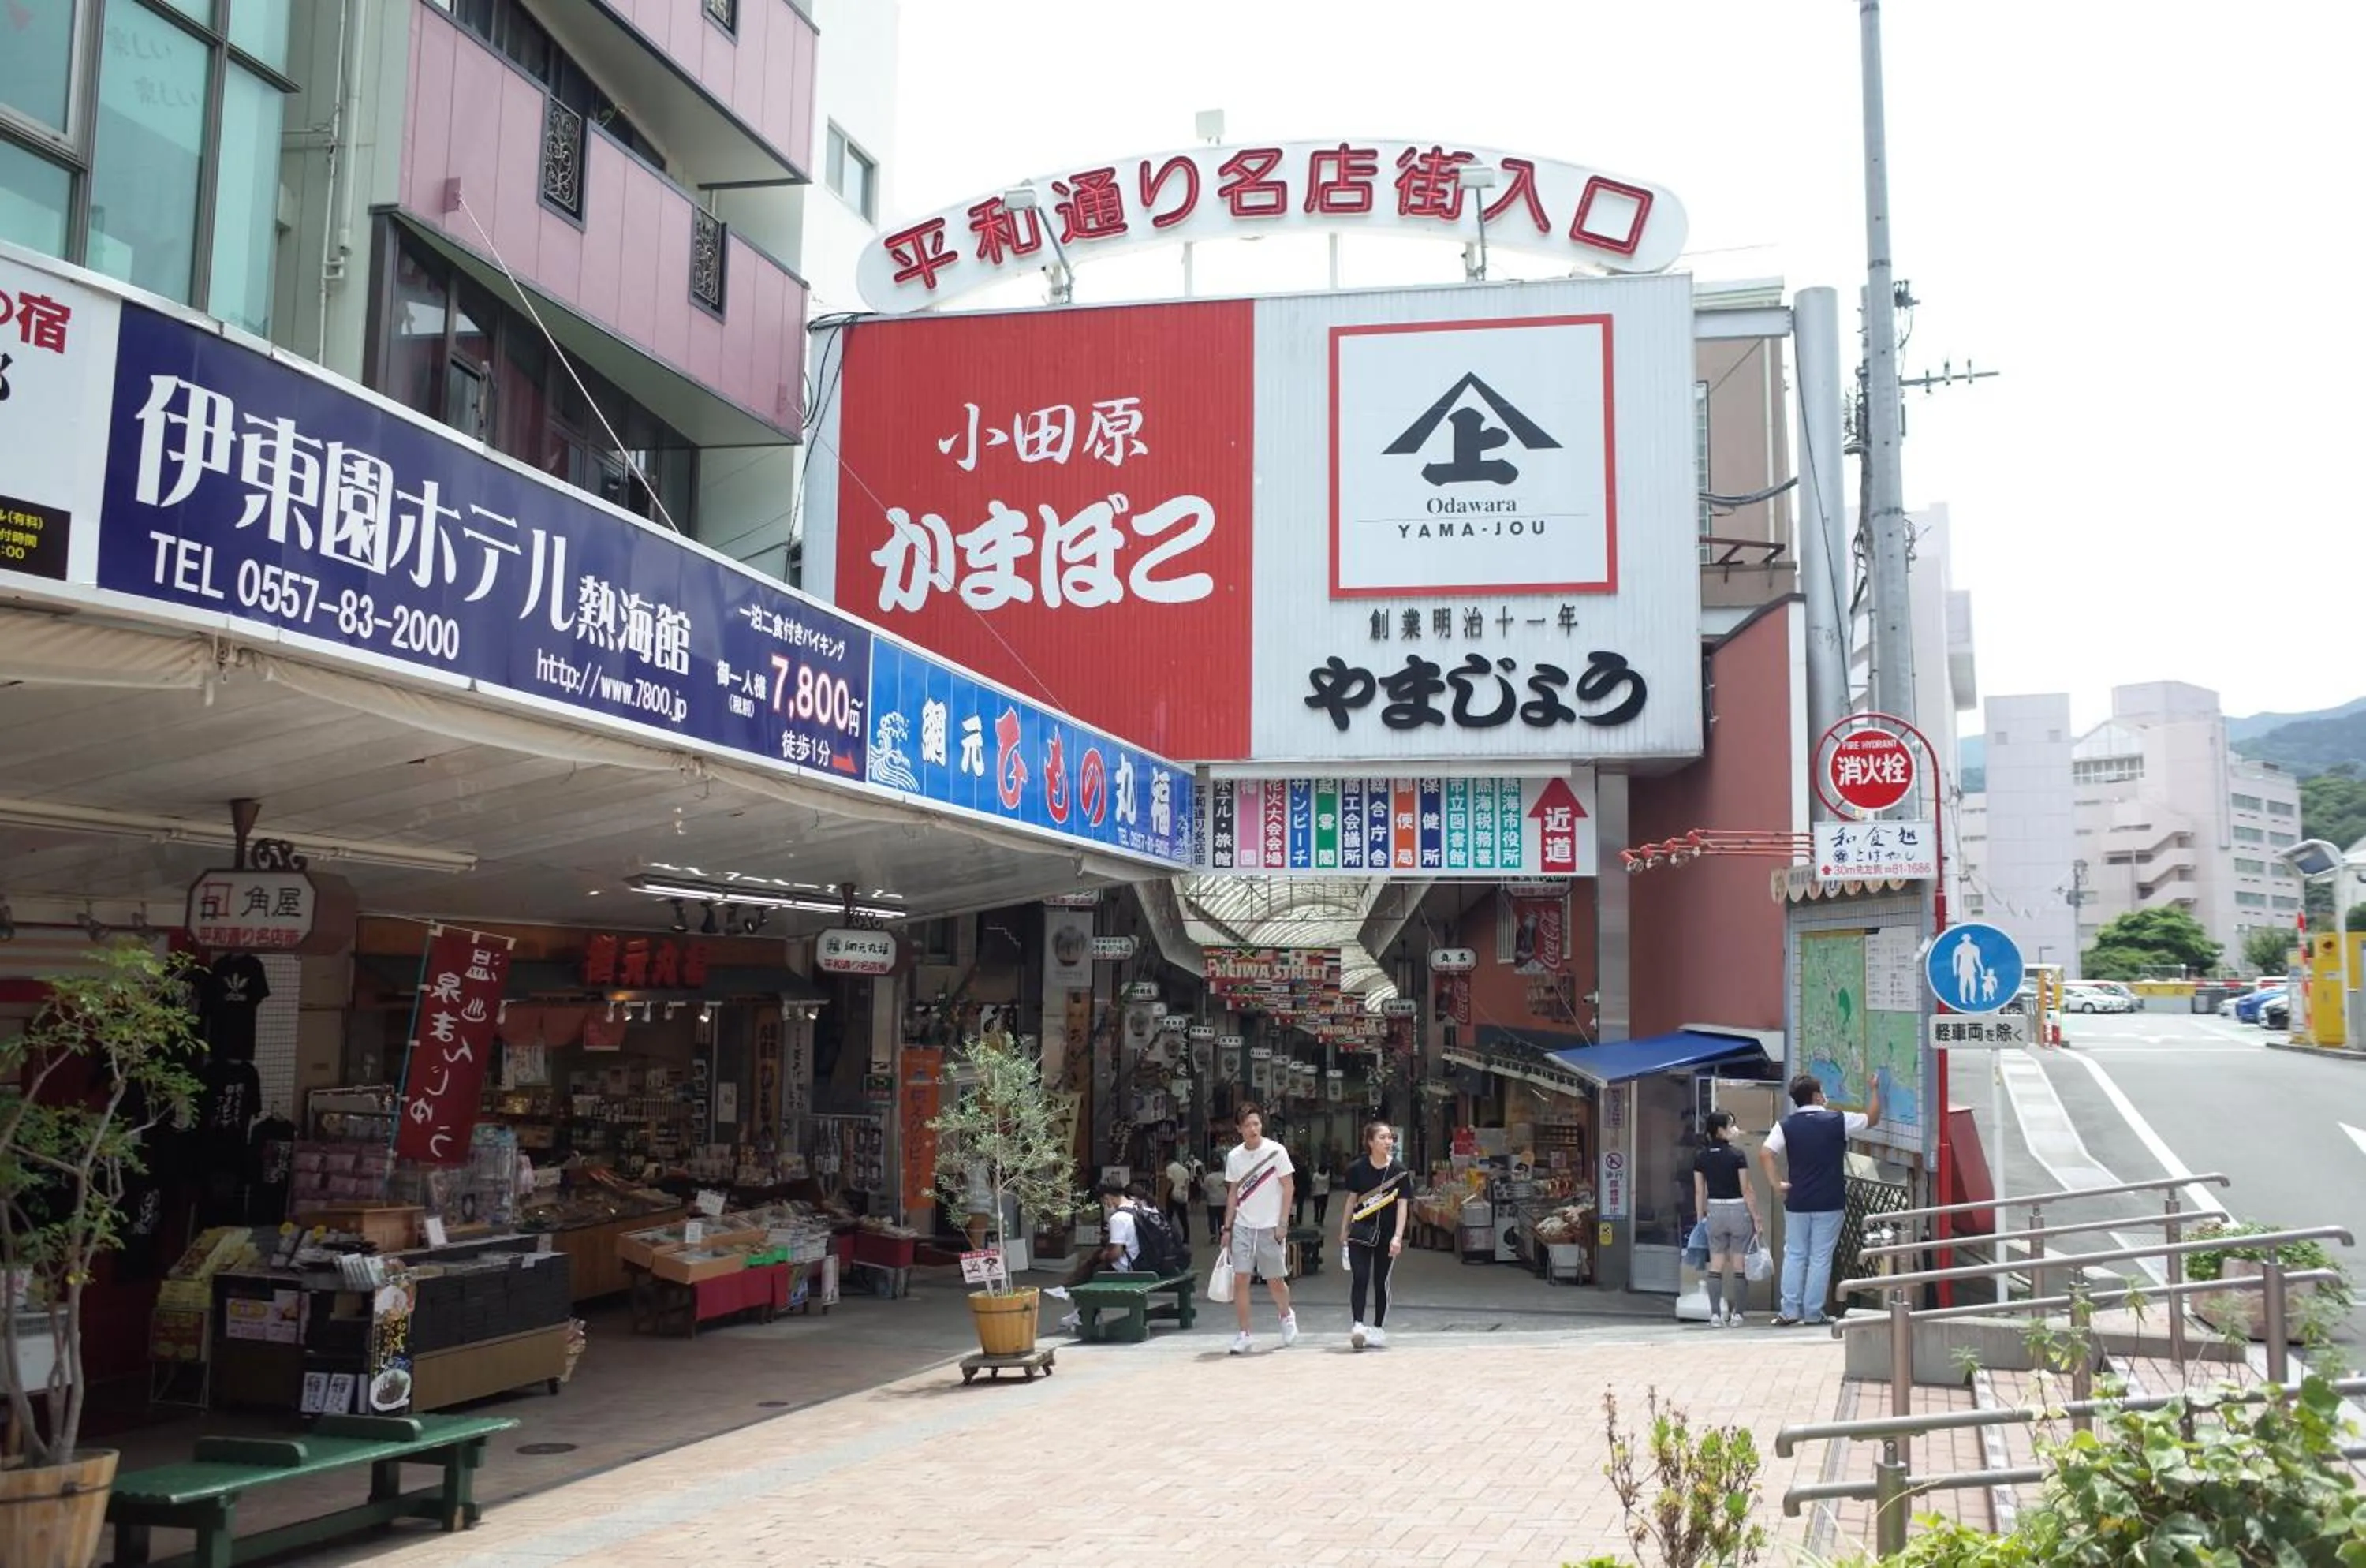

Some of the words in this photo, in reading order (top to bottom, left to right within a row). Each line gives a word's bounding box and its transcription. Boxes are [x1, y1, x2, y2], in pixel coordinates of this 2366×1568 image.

[883, 142, 1655, 289] 平和通り名店街入口
[937, 395, 1150, 472] 小田原
[1398, 519, 1547, 539] YAMA-JOU
[1426, 496, 1518, 514] Odawara
[870, 492, 1215, 614] かまぼこ
[149, 530, 225, 599] TEL
[237, 558, 460, 660] 0557-83-2000
[738, 603, 846, 662] 一泊二食付きバイキング
[1369, 604, 1579, 640] 創業明治十一年
[536, 648, 688, 725] http://www.7800.jp
[1304, 651, 1648, 733] やまじょう
[782, 730, 830, 767] 徒歩1分
[1836, 752, 1908, 786] 消火栓
[1842, 741, 1860, 750] FIRE
[1861, 739, 1898, 750] HYDRANT
[1422, 778, 1440, 866] 保健所
[1545, 806, 1572, 864] 近道
[240, 885, 303, 917] 角屋
[1540, 909, 1561, 969] Coca-Cola
[1272, 959, 1331, 980] STREET
[1453, 978, 1469, 1024] Coca-Cola
[1935, 1022, 2024, 1043] 軽車両を除く
